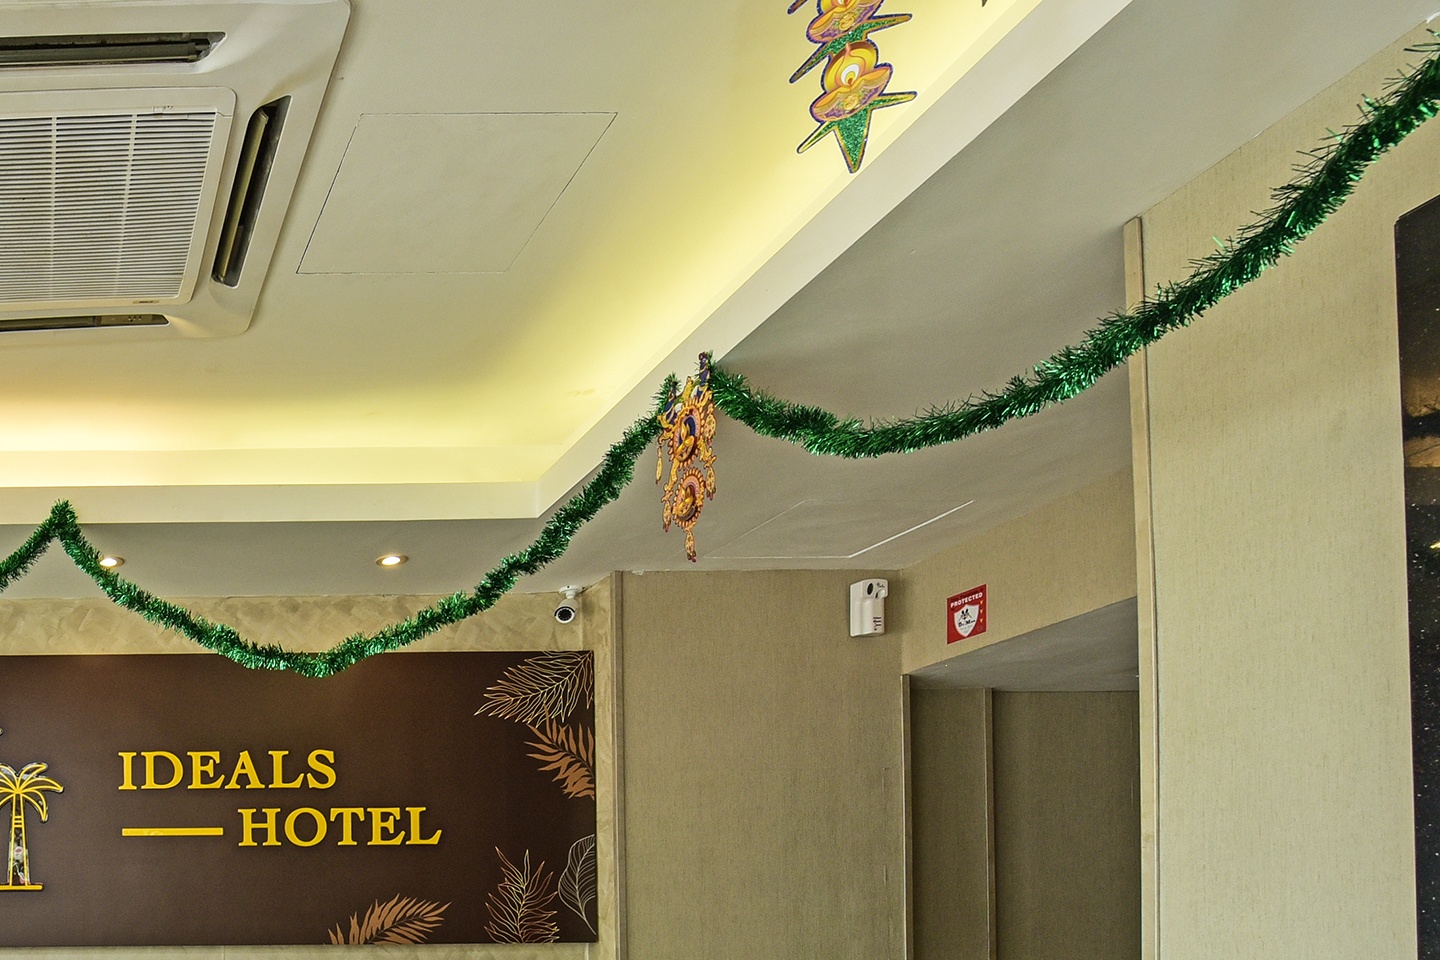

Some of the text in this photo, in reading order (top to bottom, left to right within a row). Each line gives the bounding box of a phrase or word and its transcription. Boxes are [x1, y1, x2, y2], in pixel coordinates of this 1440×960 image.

[950, 592, 983, 608] PROTECTED
[117, 748, 338, 790] IDEALS
[237, 806, 443, 847] HOTEL
